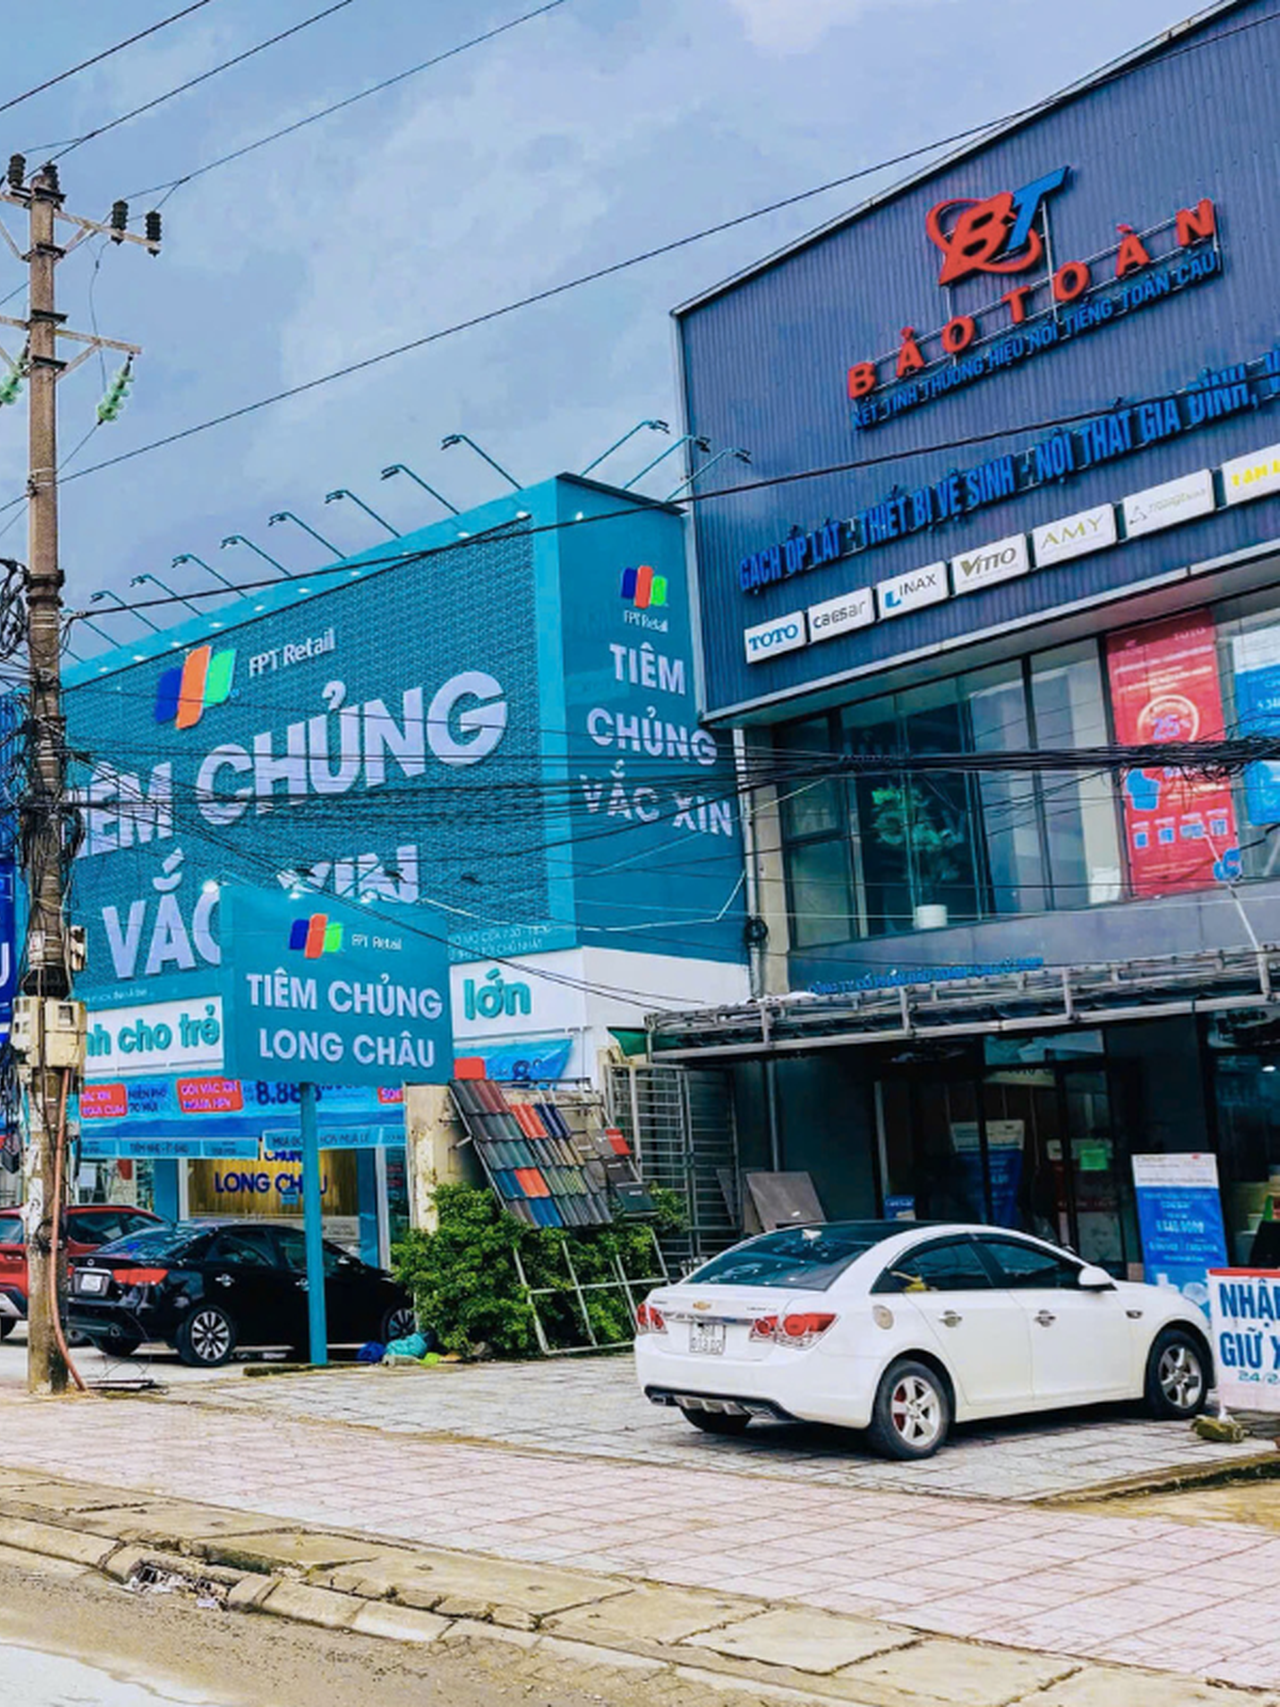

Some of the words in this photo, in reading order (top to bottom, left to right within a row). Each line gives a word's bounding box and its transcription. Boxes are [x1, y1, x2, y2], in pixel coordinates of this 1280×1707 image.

[847, 315, 975, 399] BẢO
[1000, 198, 1215, 325] TOÀN
[740, 544, 782, 595] GẠCH
[859, 485, 908, 545] THIẾT
[912, 486, 934, 532] BỊ
[936, 468, 962, 521] VỆ
[967, 454, 1015, 508] SINH
[1036, 427, 1075, 484] NỘI
[1139, 398, 1182, 441] GIA
[1040, 514, 1104, 549] AMY
[899, 573, 938, 597] INAX
[748, 624, 799, 651] TOTO
[812, 601, 866, 629] caesar
[248, 647, 280, 679] FPT
[282, 628, 336, 667] Retail
[609, 641, 686, 696] TIÊM
[195, 670, 509, 827] CHỦNG
[587, 705, 718, 766] CHỦNG
[579, 759, 660, 822] VẮC
[671, 791, 734, 837] XIN
[245, 966, 318, 1011] TIÊM
[327, 972, 444, 1020] CHỦNG
[463, 967, 532, 1021] lớn
[118, 1018, 173, 1054] cho
[179, 1004, 221, 1049] trẻ
[259, 1028, 344, 1063] LONG
[353, 1030, 435, 1068] CHÂU
[215, 1172, 271, 1194] LONG
[1220, 1326, 1264, 1369] GIỮ
